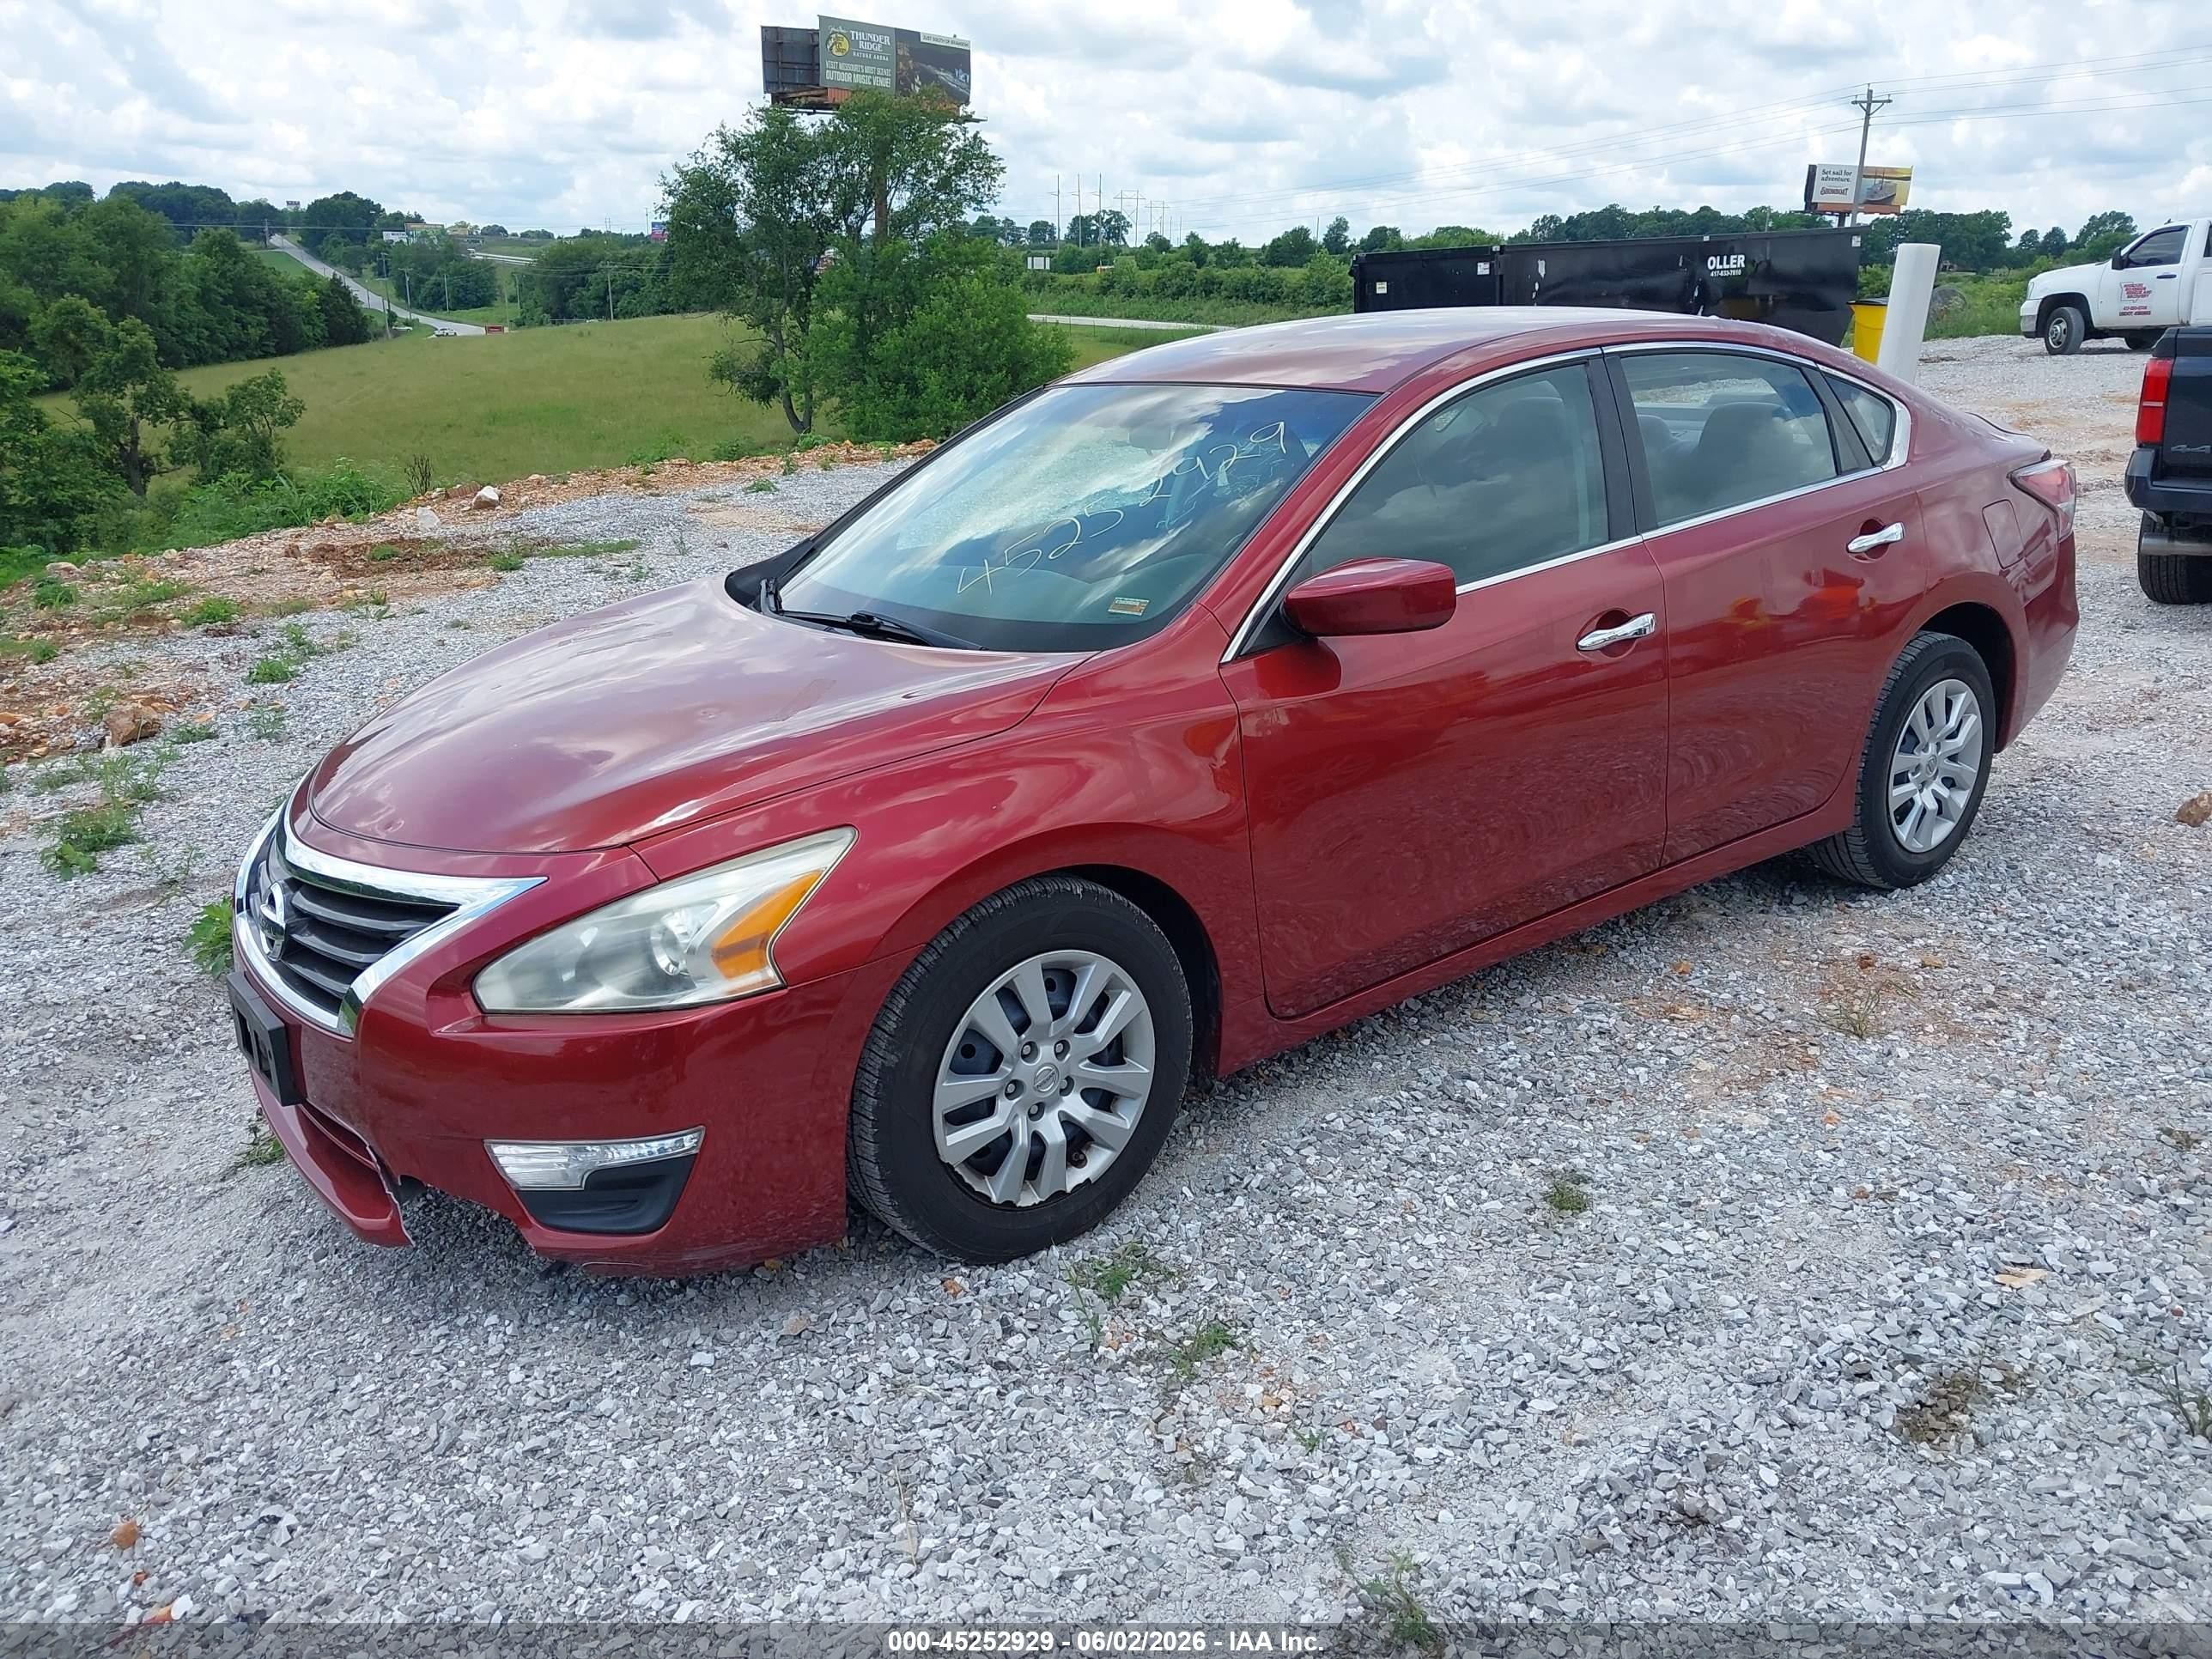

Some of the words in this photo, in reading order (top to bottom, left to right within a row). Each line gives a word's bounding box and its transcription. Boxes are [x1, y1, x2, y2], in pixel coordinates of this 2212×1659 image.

[850, 30, 891, 46] THUNDER
[859, 40, 884, 52] RIDGE
[825, 59, 838, 70] VISIT
[865, 65, 877, 75] MOST
[877, 67, 891, 77] SCENIC
[825, 70, 852, 83] OUTDOOR
[853, 73, 872, 85] MUSIC
[1707, 254, 1746, 270] OLLER
